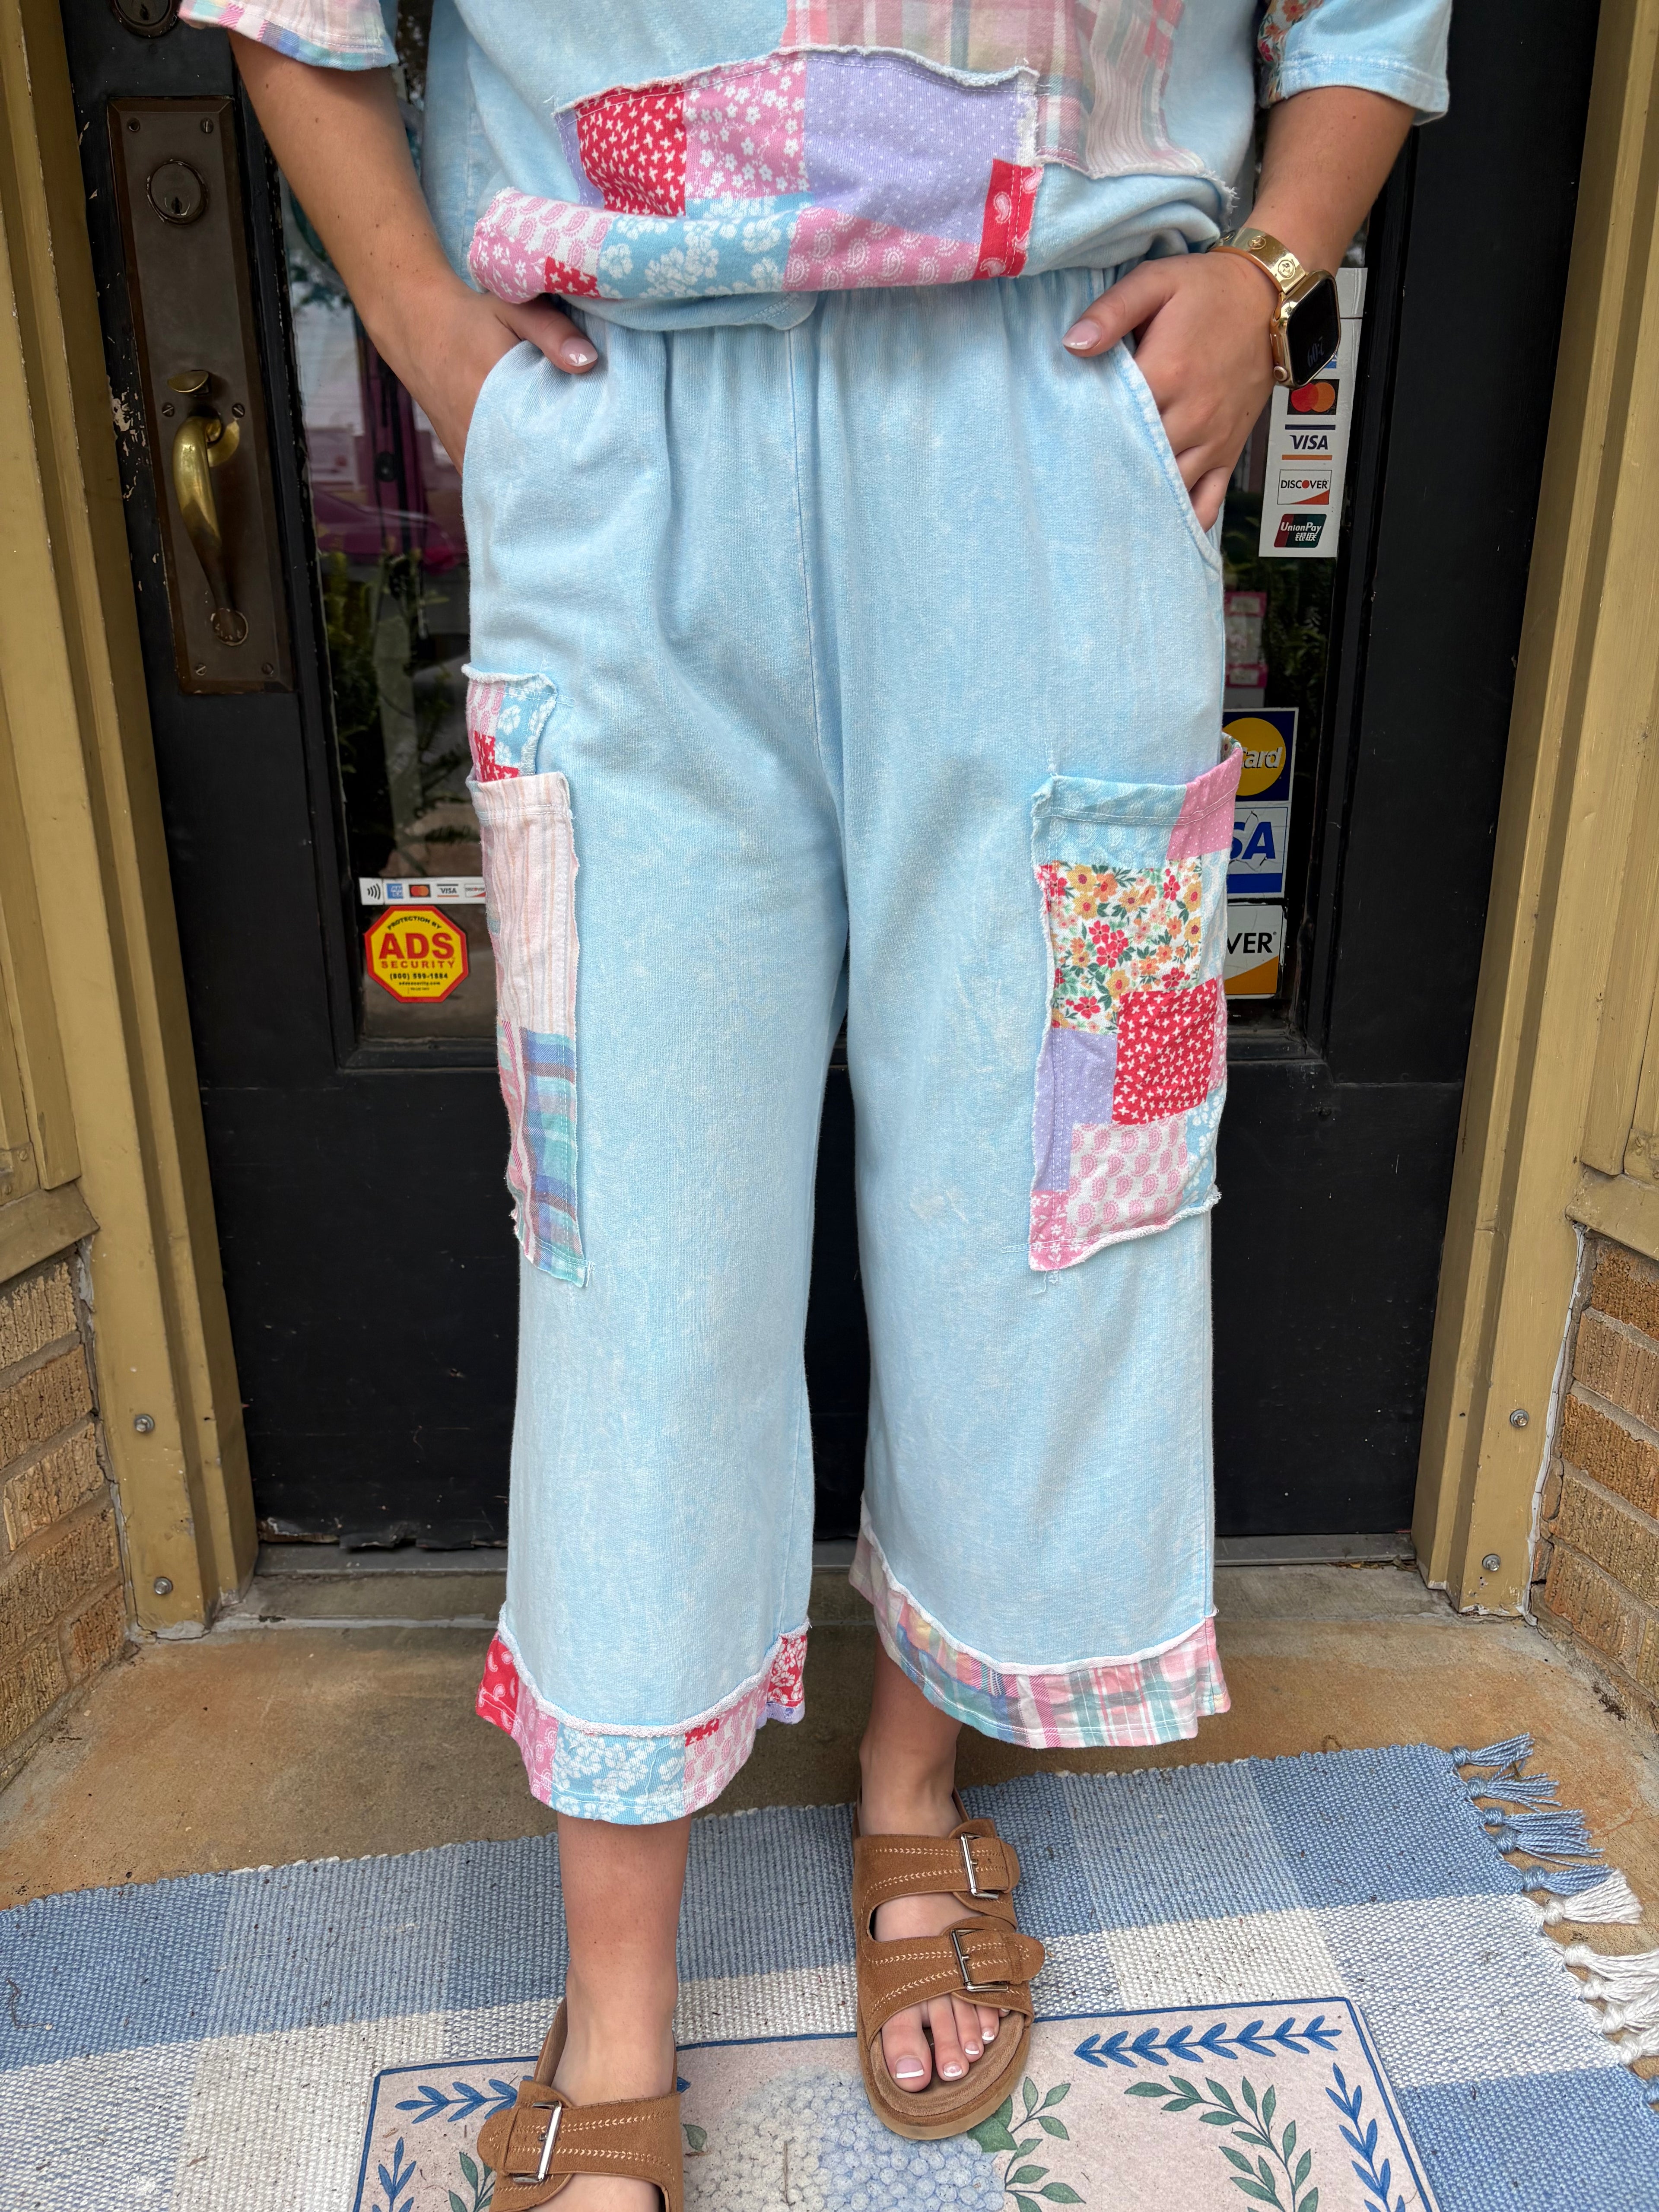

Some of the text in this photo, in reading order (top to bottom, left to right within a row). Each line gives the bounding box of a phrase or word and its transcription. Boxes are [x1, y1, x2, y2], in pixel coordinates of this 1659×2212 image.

[1289, 435, 1328, 450] VISA
[1281, 480, 1328, 489] DISCOVER
[1280, 522, 1322, 535] UnionPay
[388, 916, 430, 930] PROTECTION
[378, 933, 454, 960] ADS
[381, 960, 455, 969] SECURITY
